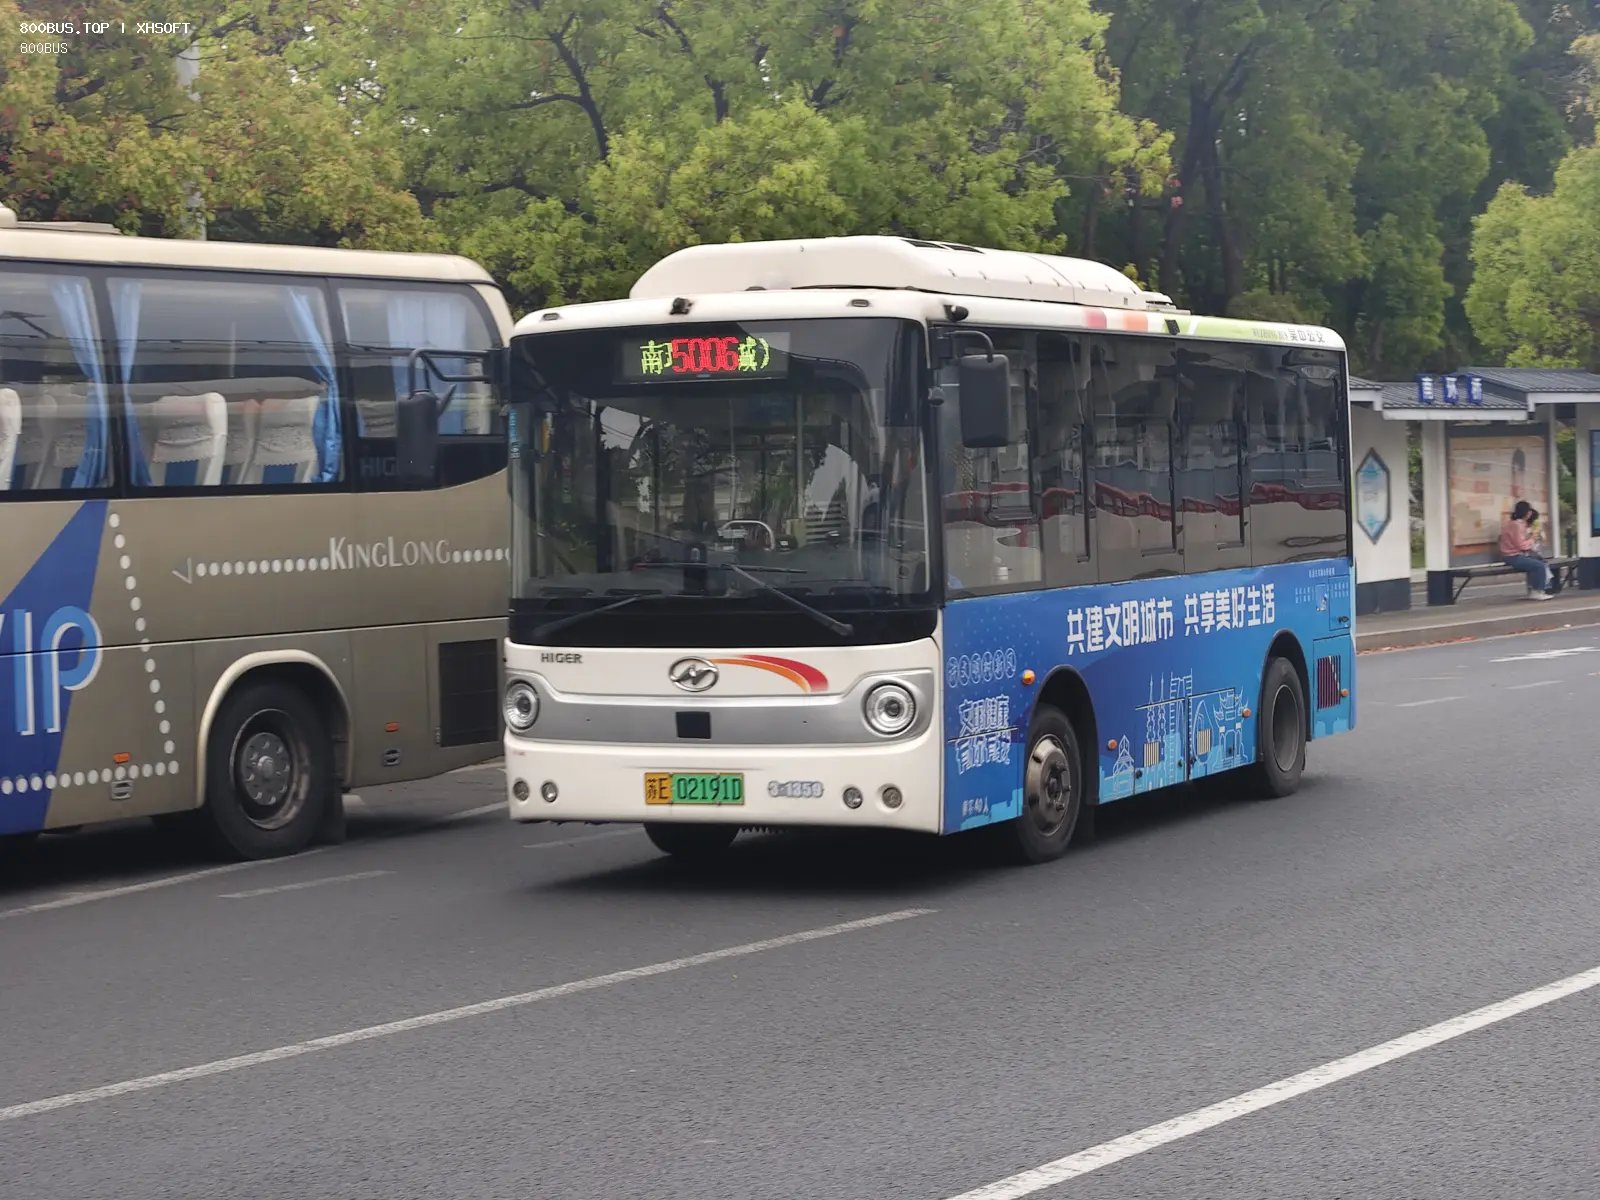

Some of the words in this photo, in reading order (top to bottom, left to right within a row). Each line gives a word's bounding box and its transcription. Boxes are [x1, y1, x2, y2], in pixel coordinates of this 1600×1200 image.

[671, 336, 739, 373] 5006
[1067, 596, 1174, 656] 共建文明城市
[1184, 583, 1275, 637] 共享美好生活
[0, 605, 103, 736] IP
[541, 652, 583, 664] HIGER
